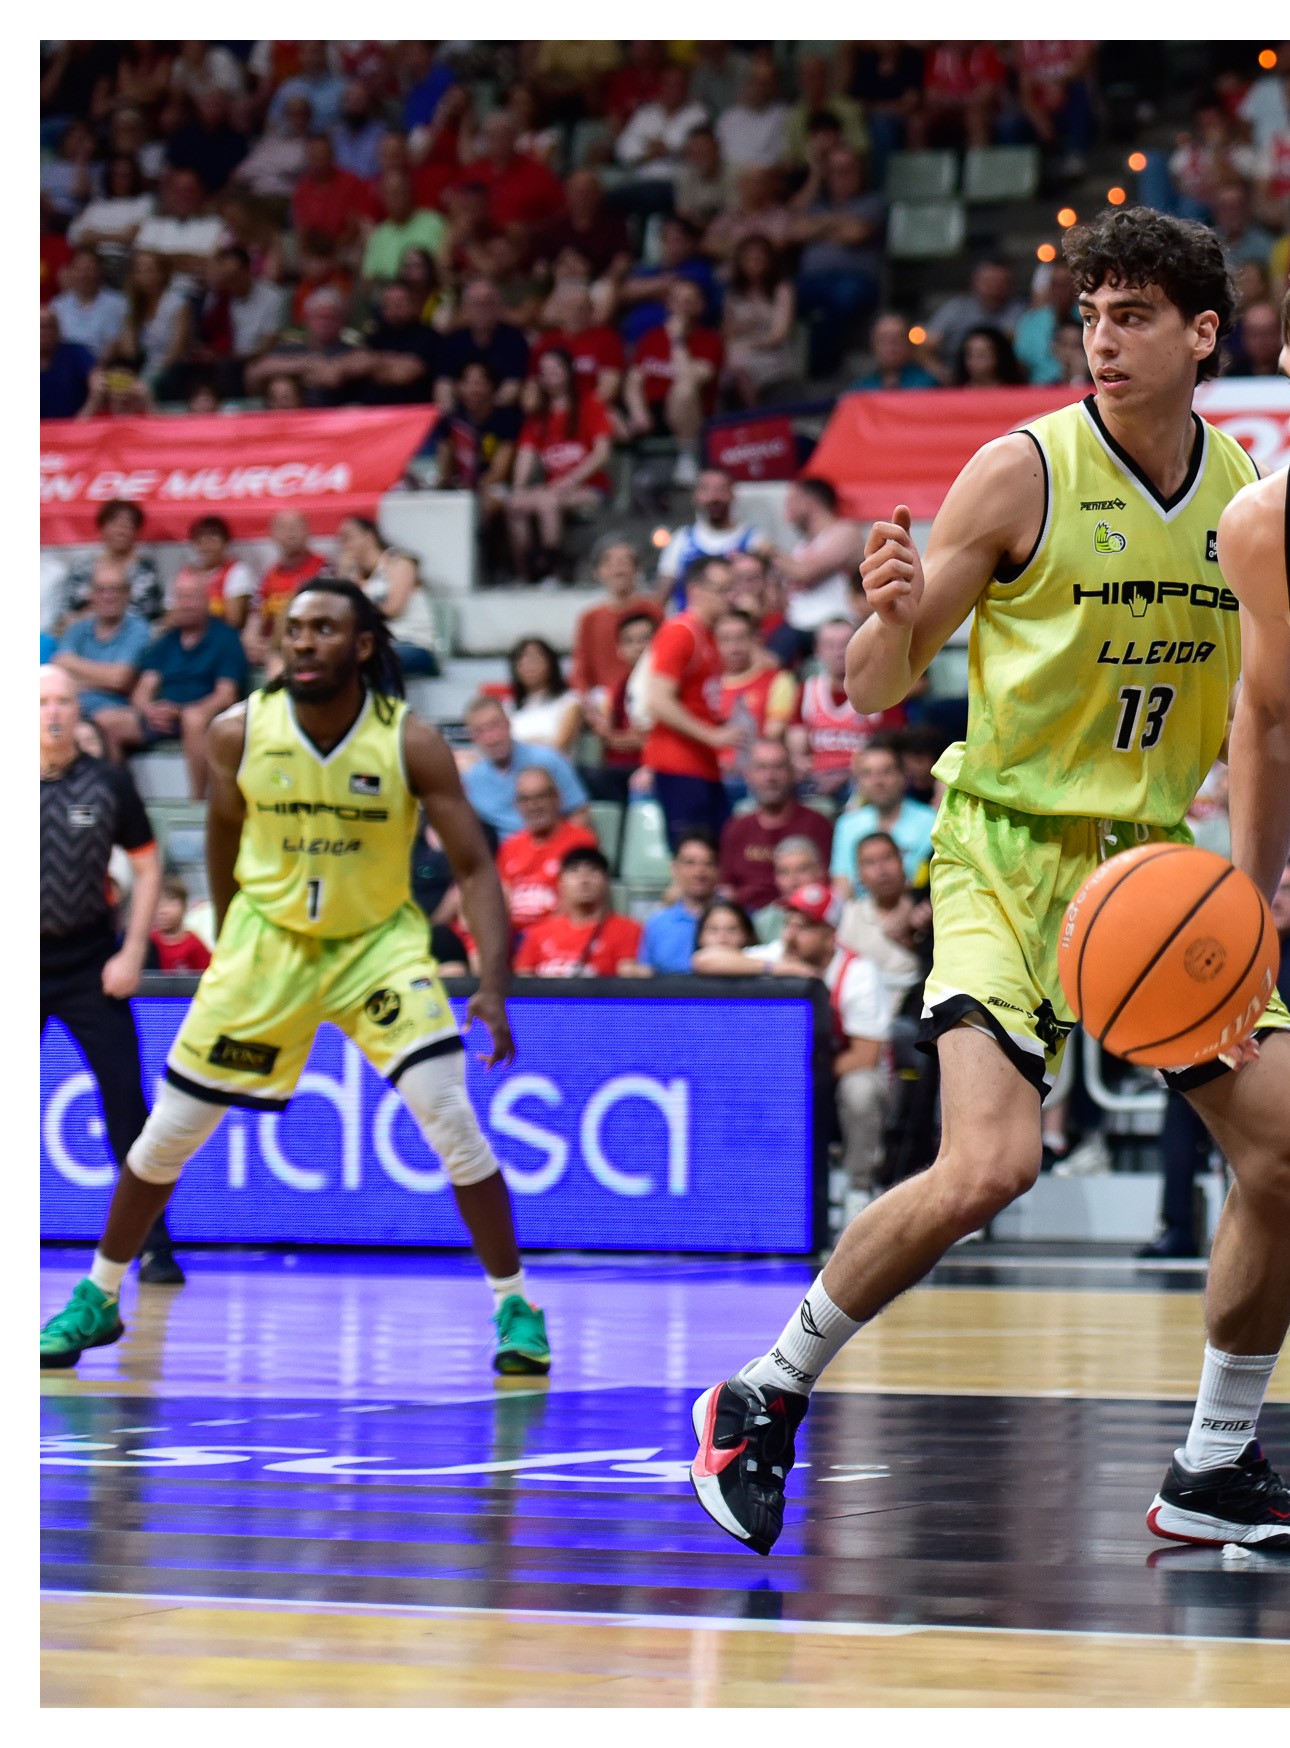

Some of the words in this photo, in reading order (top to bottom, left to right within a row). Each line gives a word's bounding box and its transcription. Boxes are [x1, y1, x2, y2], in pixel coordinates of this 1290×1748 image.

[157, 461, 351, 499] MURCIA
[1097, 639, 1218, 665] LLEIDA
[1112, 682, 1177, 753] 13
[307, 877, 324, 921] 1
[43, 1038, 689, 1197] edesa
